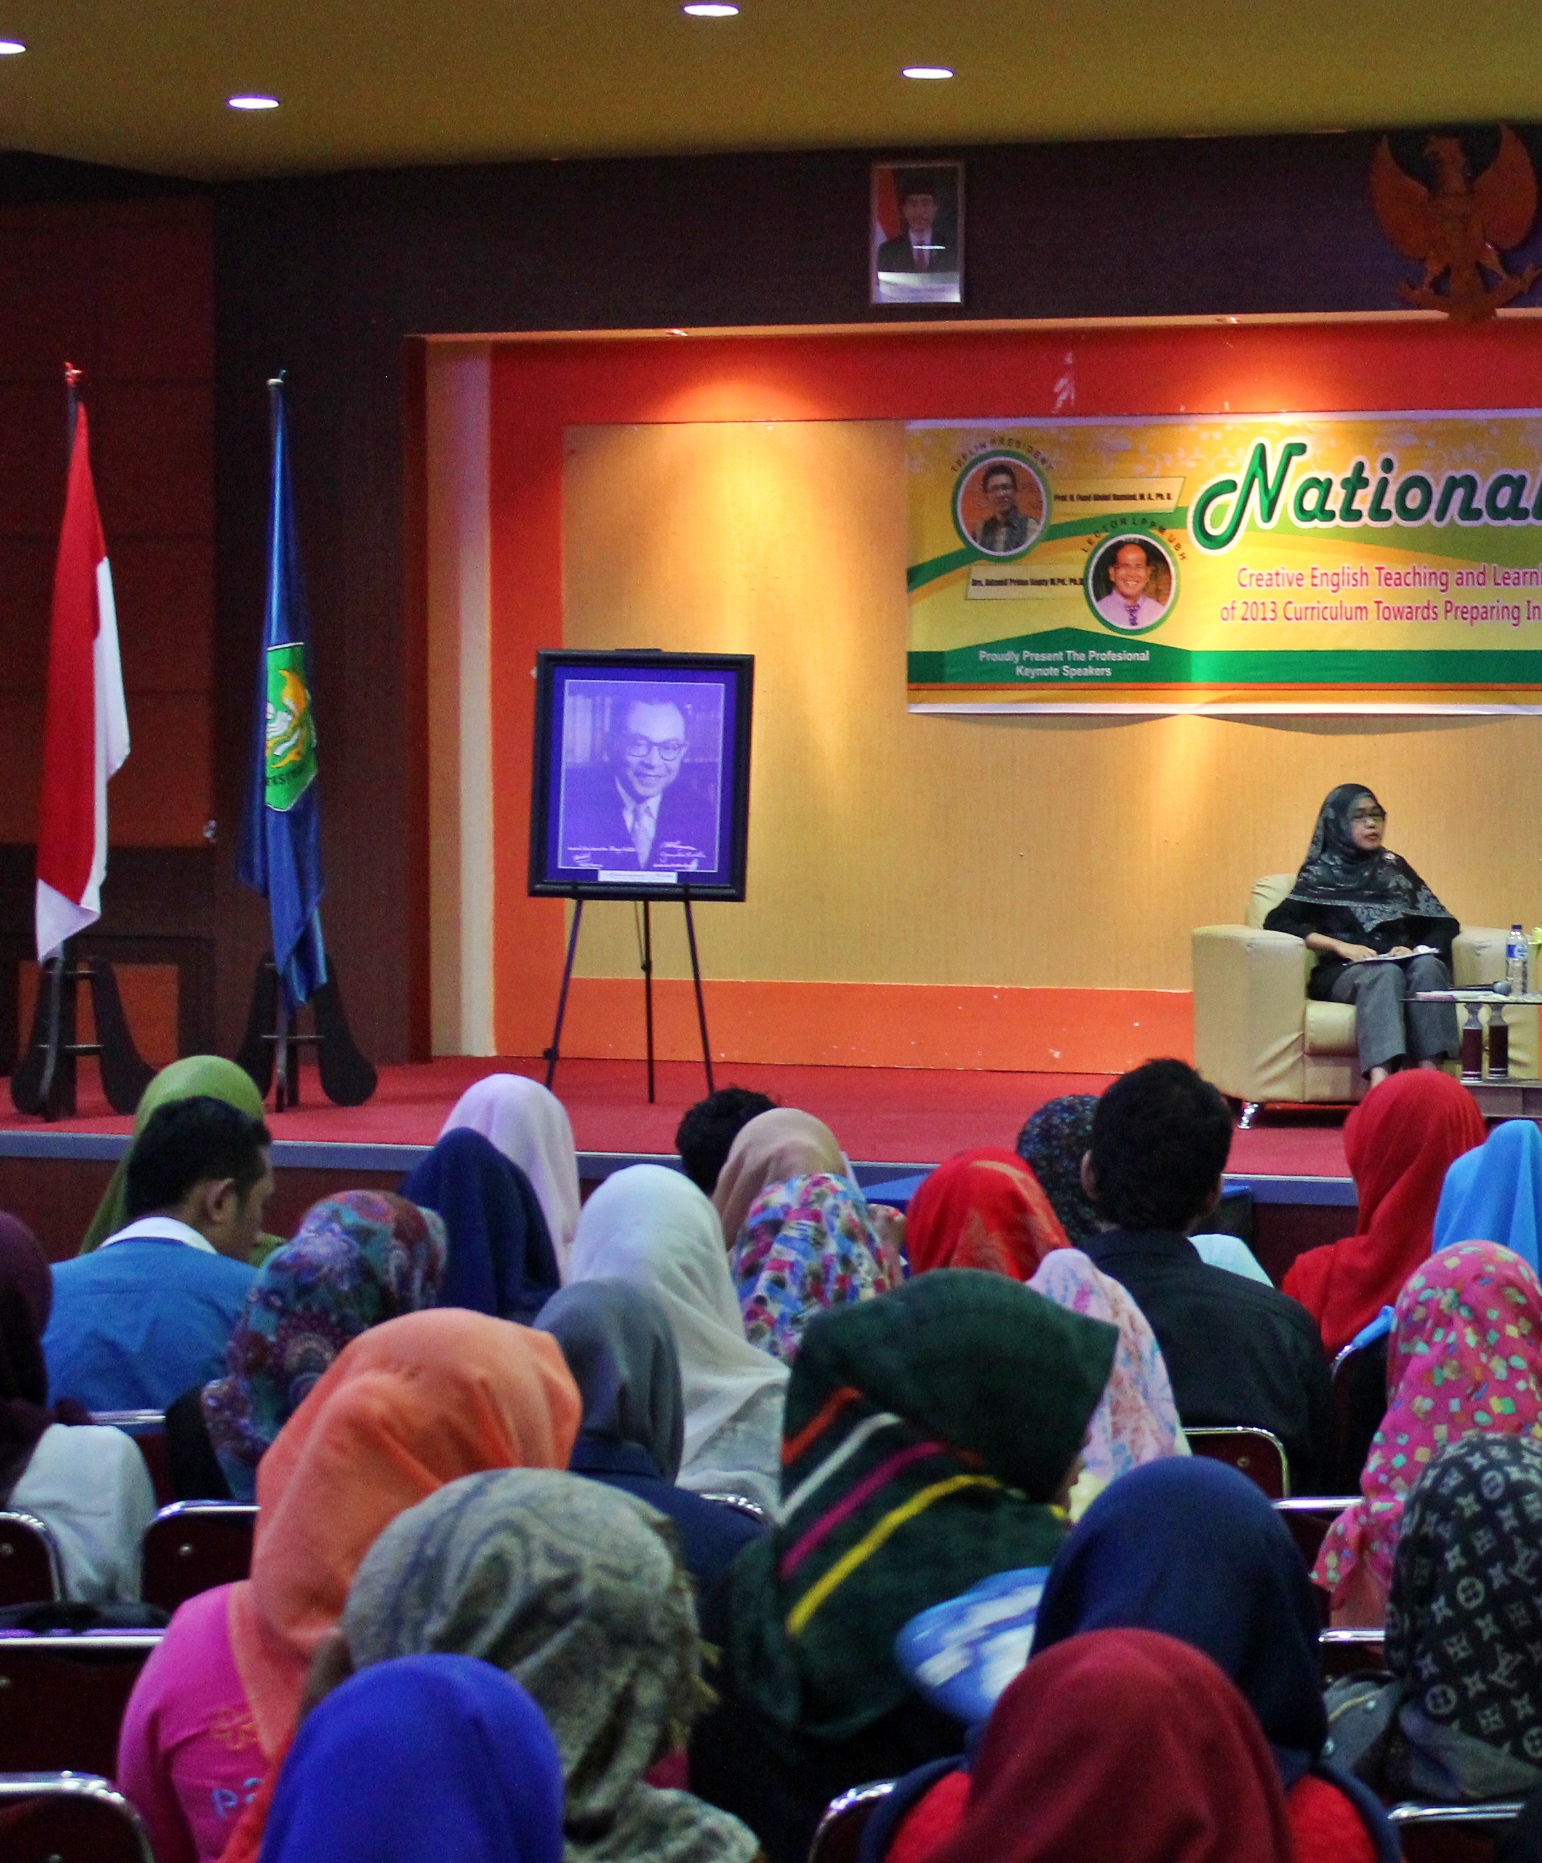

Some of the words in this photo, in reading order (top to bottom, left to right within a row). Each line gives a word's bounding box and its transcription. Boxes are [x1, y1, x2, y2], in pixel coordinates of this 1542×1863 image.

[1168, 534, 1187, 560] UBH
[1237, 567, 1304, 588] Creative
[1310, 564, 1369, 592] English
[1375, 564, 1449, 592] Teaching
[1455, 563, 1487, 587] and
[1220, 600, 1237, 621] of
[1241, 600, 1277, 621] 2013
[1283, 600, 1368, 621] Curriculum
[1374, 600, 1438, 621] Towards
[1444, 600, 1521, 626] Preparing
[979, 651, 1020, 663] Proudly
[1023, 651, 1063, 661] Present
[1066, 651, 1086, 661] The
[1088, 651, 1149, 661] Profesional
[1016, 666, 1059, 679] Keynote
[1062, 666, 1112, 678] Speakers
